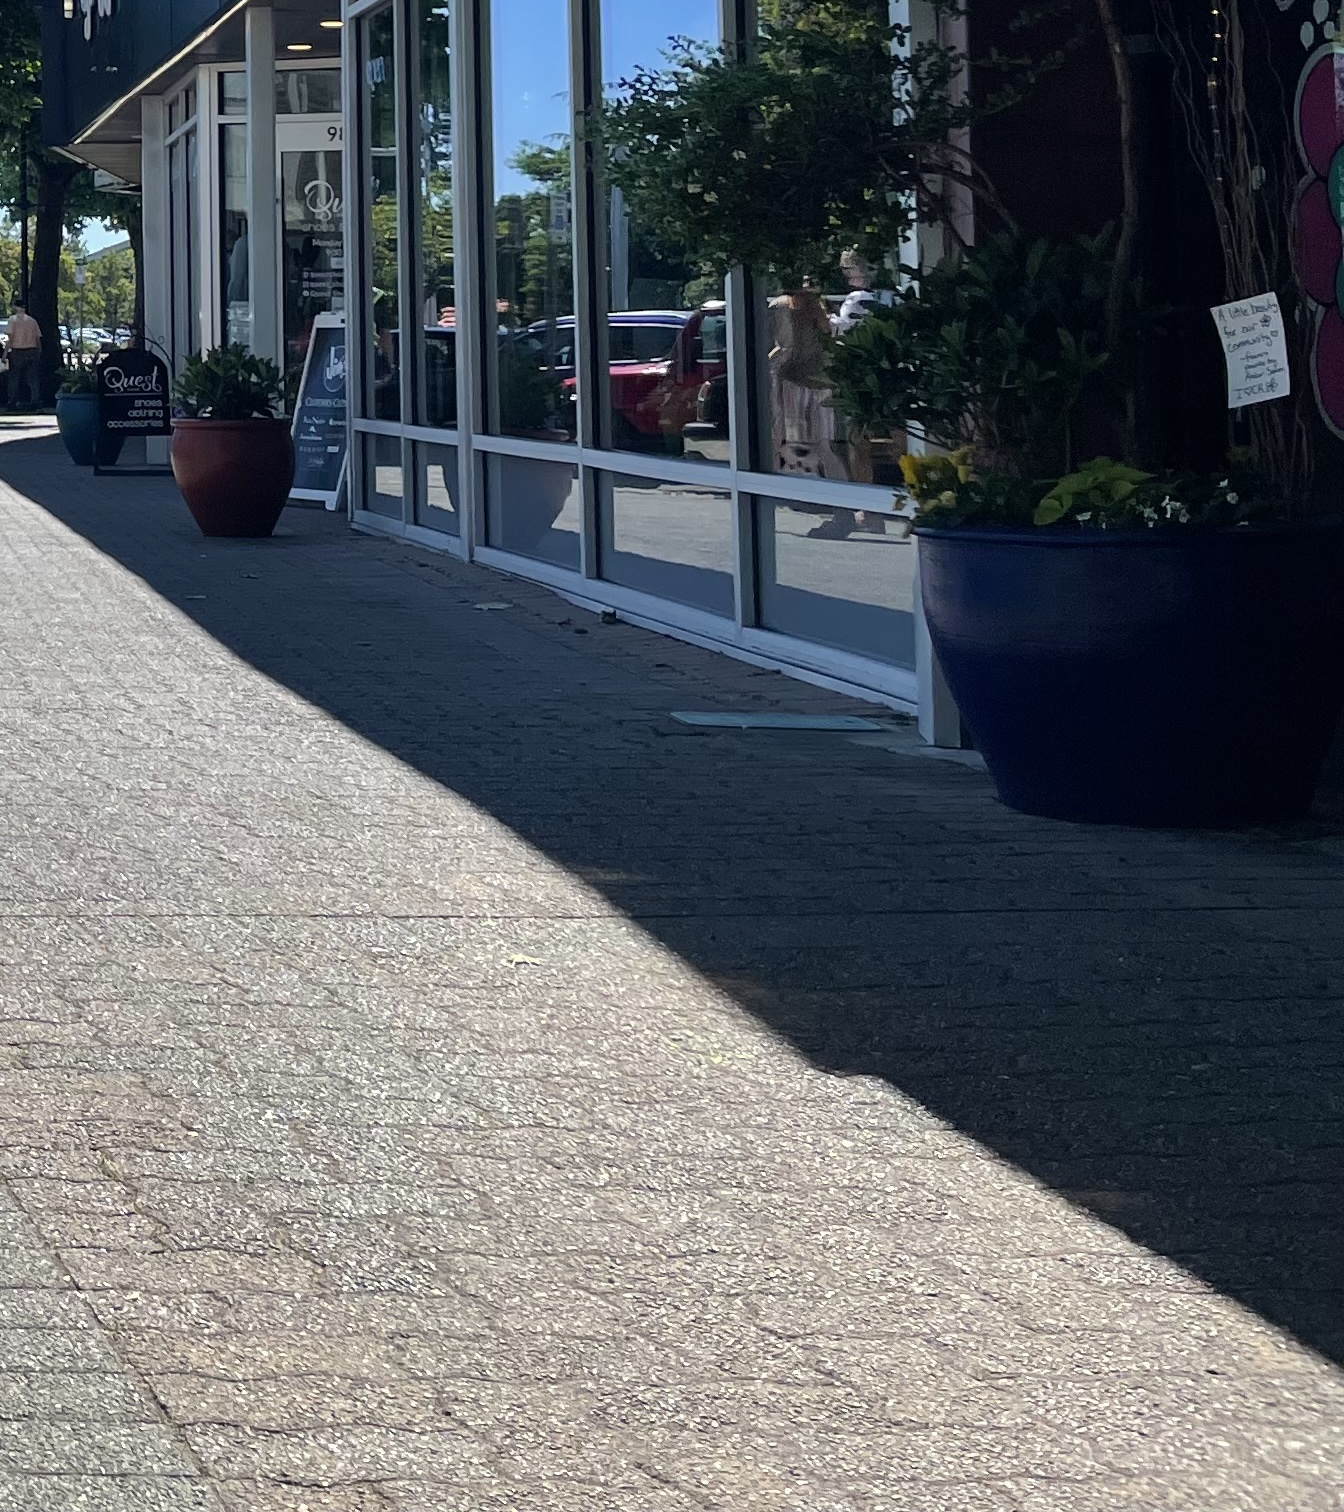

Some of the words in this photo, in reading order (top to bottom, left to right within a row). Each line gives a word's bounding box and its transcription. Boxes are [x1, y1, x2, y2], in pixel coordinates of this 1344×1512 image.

[103, 365, 163, 393] Quest
[134, 399, 163, 407] shoes
[127, 409, 163, 418] clothing
[107, 419, 164, 428] accessories
